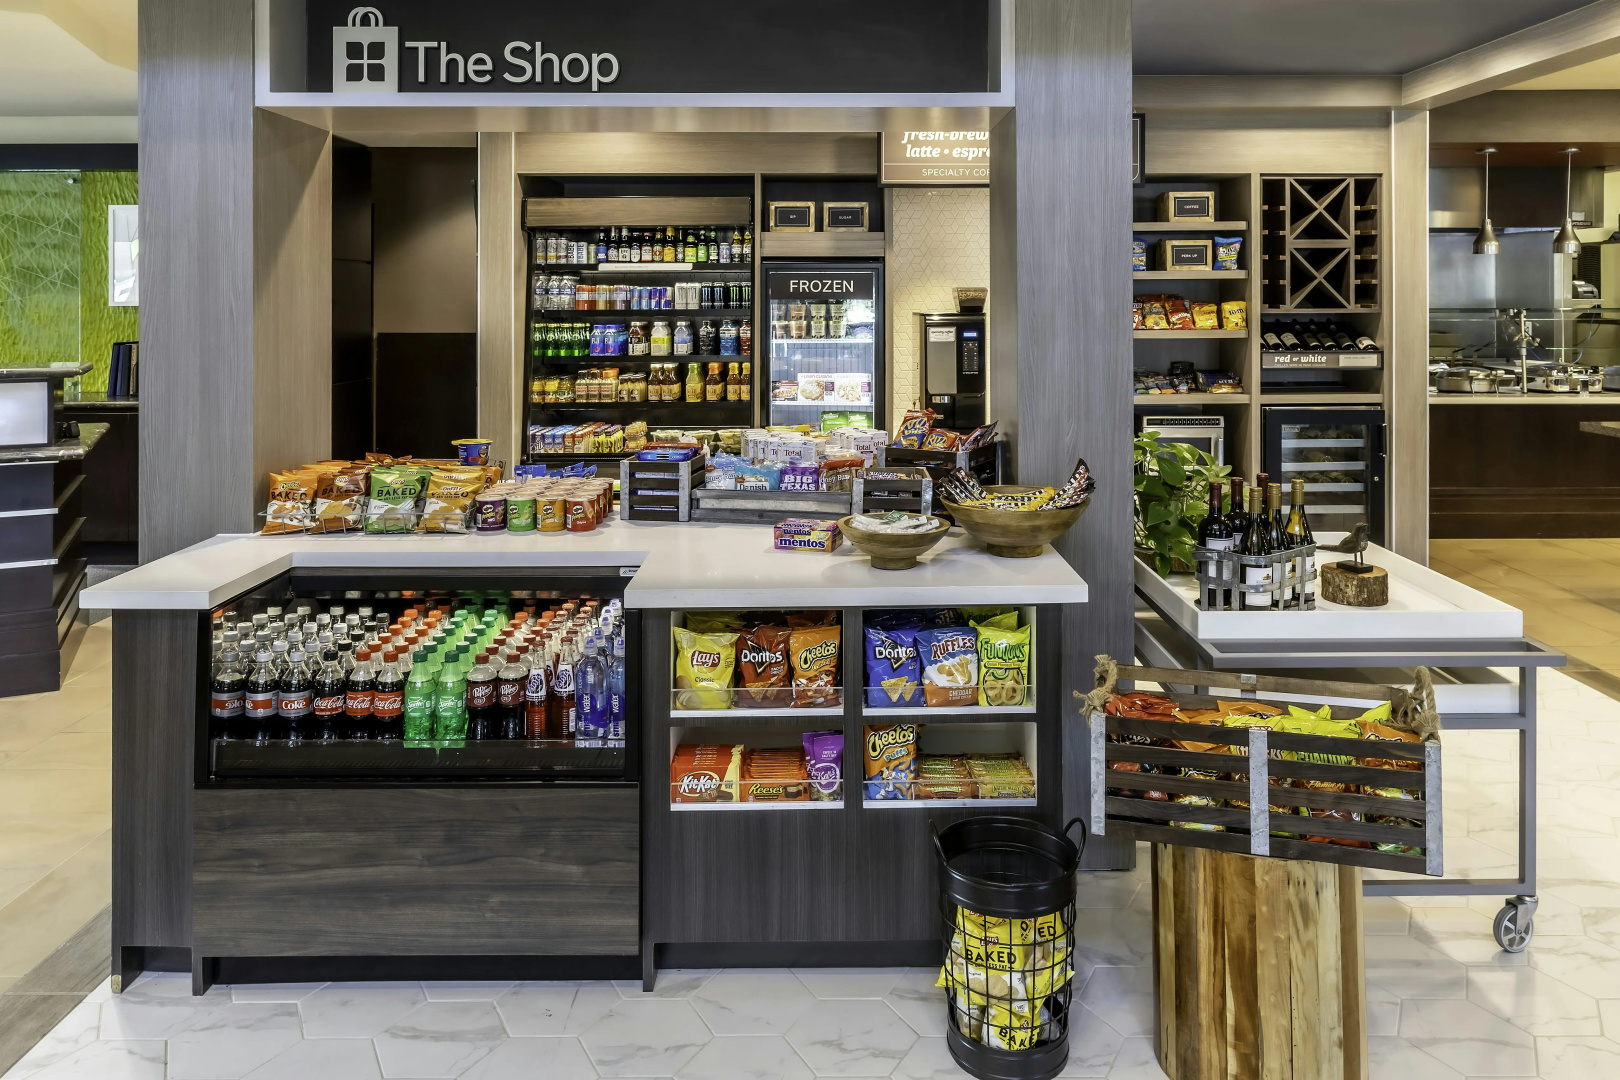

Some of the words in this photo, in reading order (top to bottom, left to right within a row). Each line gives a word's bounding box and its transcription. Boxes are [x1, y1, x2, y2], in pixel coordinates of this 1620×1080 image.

[405, 41, 494, 84] The
[502, 40, 620, 92] Shop
[905, 144, 941, 158] latte
[922, 168, 971, 176] SPECIALTY
[789, 280, 854, 293] FROZEN
[1274, 354, 1291, 363] red
[1300, 354, 1327, 363] white
[784, 449, 802, 457] Total
[783, 474, 813, 483] BIG
[321, 486, 361, 496] BAKED
[377, 488, 416, 497] BAKED
[779, 483, 816, 491] TEXAS
[270, 491, 307, 500] BAKED
[779, 538, 826, 548] mentos
[875, 646, 916, 659] Doritos
[931, 636, 976, 660] RUFFLES
[693, 650, 719, 667] Lay's
[741, 650, 783, 664] Doritos
[800, 641, 837, 670] Cheetos
[949, 689, 973, 697] CHEDDAR
[282, 700, 306, 710] Coke
[313, 694, 345, 709] Coca-Cola
[407, 699, 424, 710] Sprite
[439, 699, 456, 710] Sprite
[868, 724, 915, 759] Cheetos
[884, 746, 909, 762] Puffs
[965, 948, 1017, 964] BAKED
